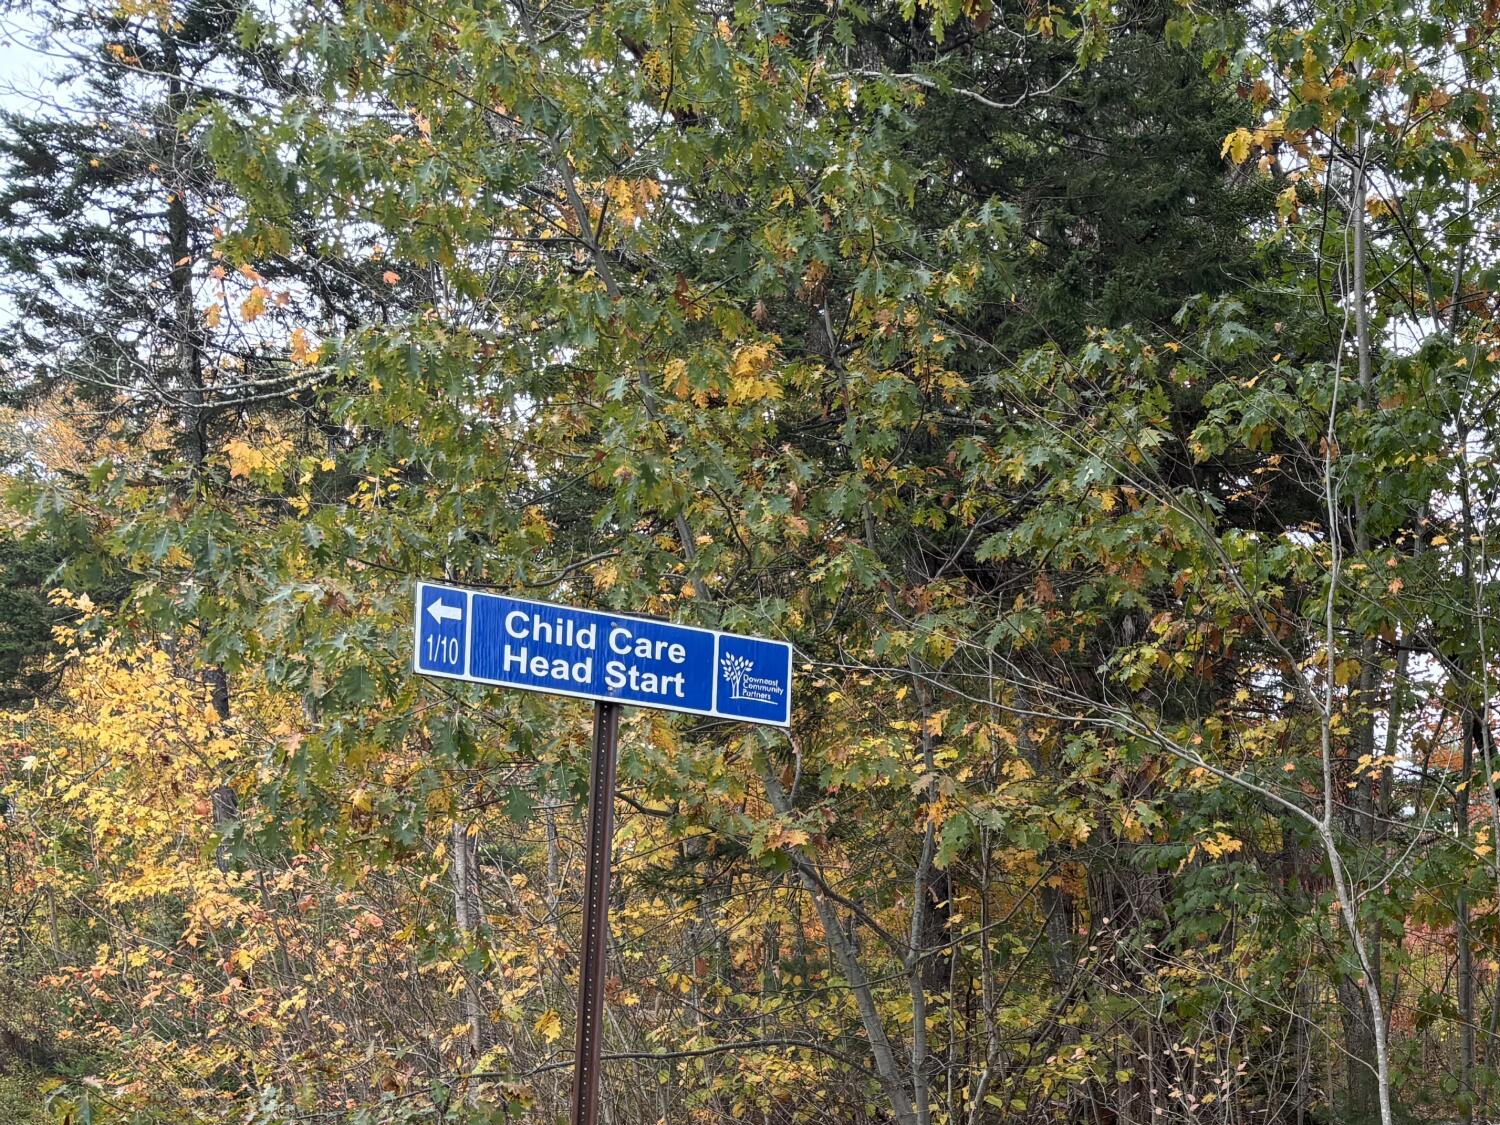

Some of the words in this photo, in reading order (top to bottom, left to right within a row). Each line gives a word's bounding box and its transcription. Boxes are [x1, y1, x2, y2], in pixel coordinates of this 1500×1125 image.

[504, 610, 597, 650] Child
[608, 627, 687, 664] Care
[426, 633, 459, 665] 1/10
[503, 645, 594, 684] Head
[605, 660, 685, 698] Start
[743, 674, 779, 687] Downeast
[742, 689, 772, 700] Partners
[743, 681, 784, 695] Community
